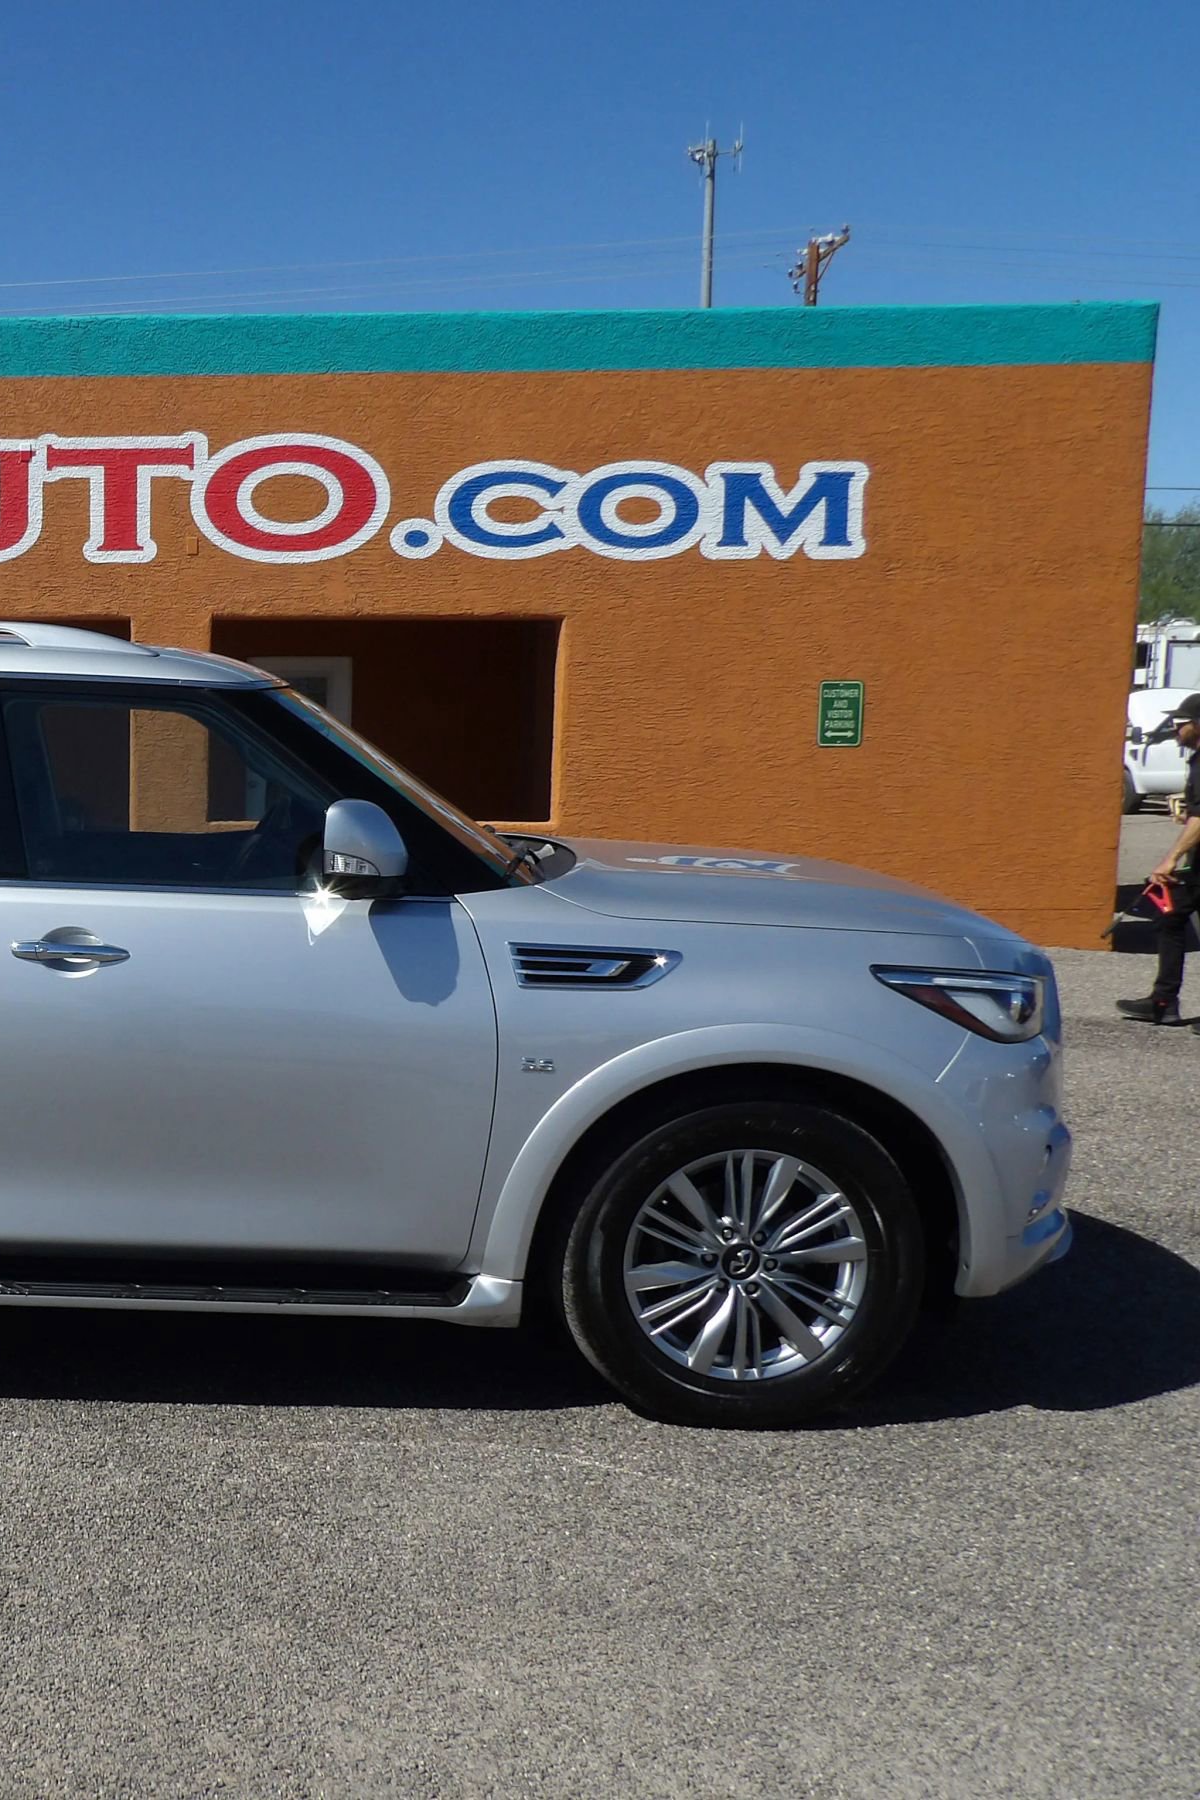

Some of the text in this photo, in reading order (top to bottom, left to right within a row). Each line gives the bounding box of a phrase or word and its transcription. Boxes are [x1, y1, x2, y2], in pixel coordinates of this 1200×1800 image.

[823, 689, 859, 698] CUSTOMER
[833, 700, 848, 709] AND
[827, 710, 853, 718] VISITOR
[824, 720, 855, 729] PARKING
